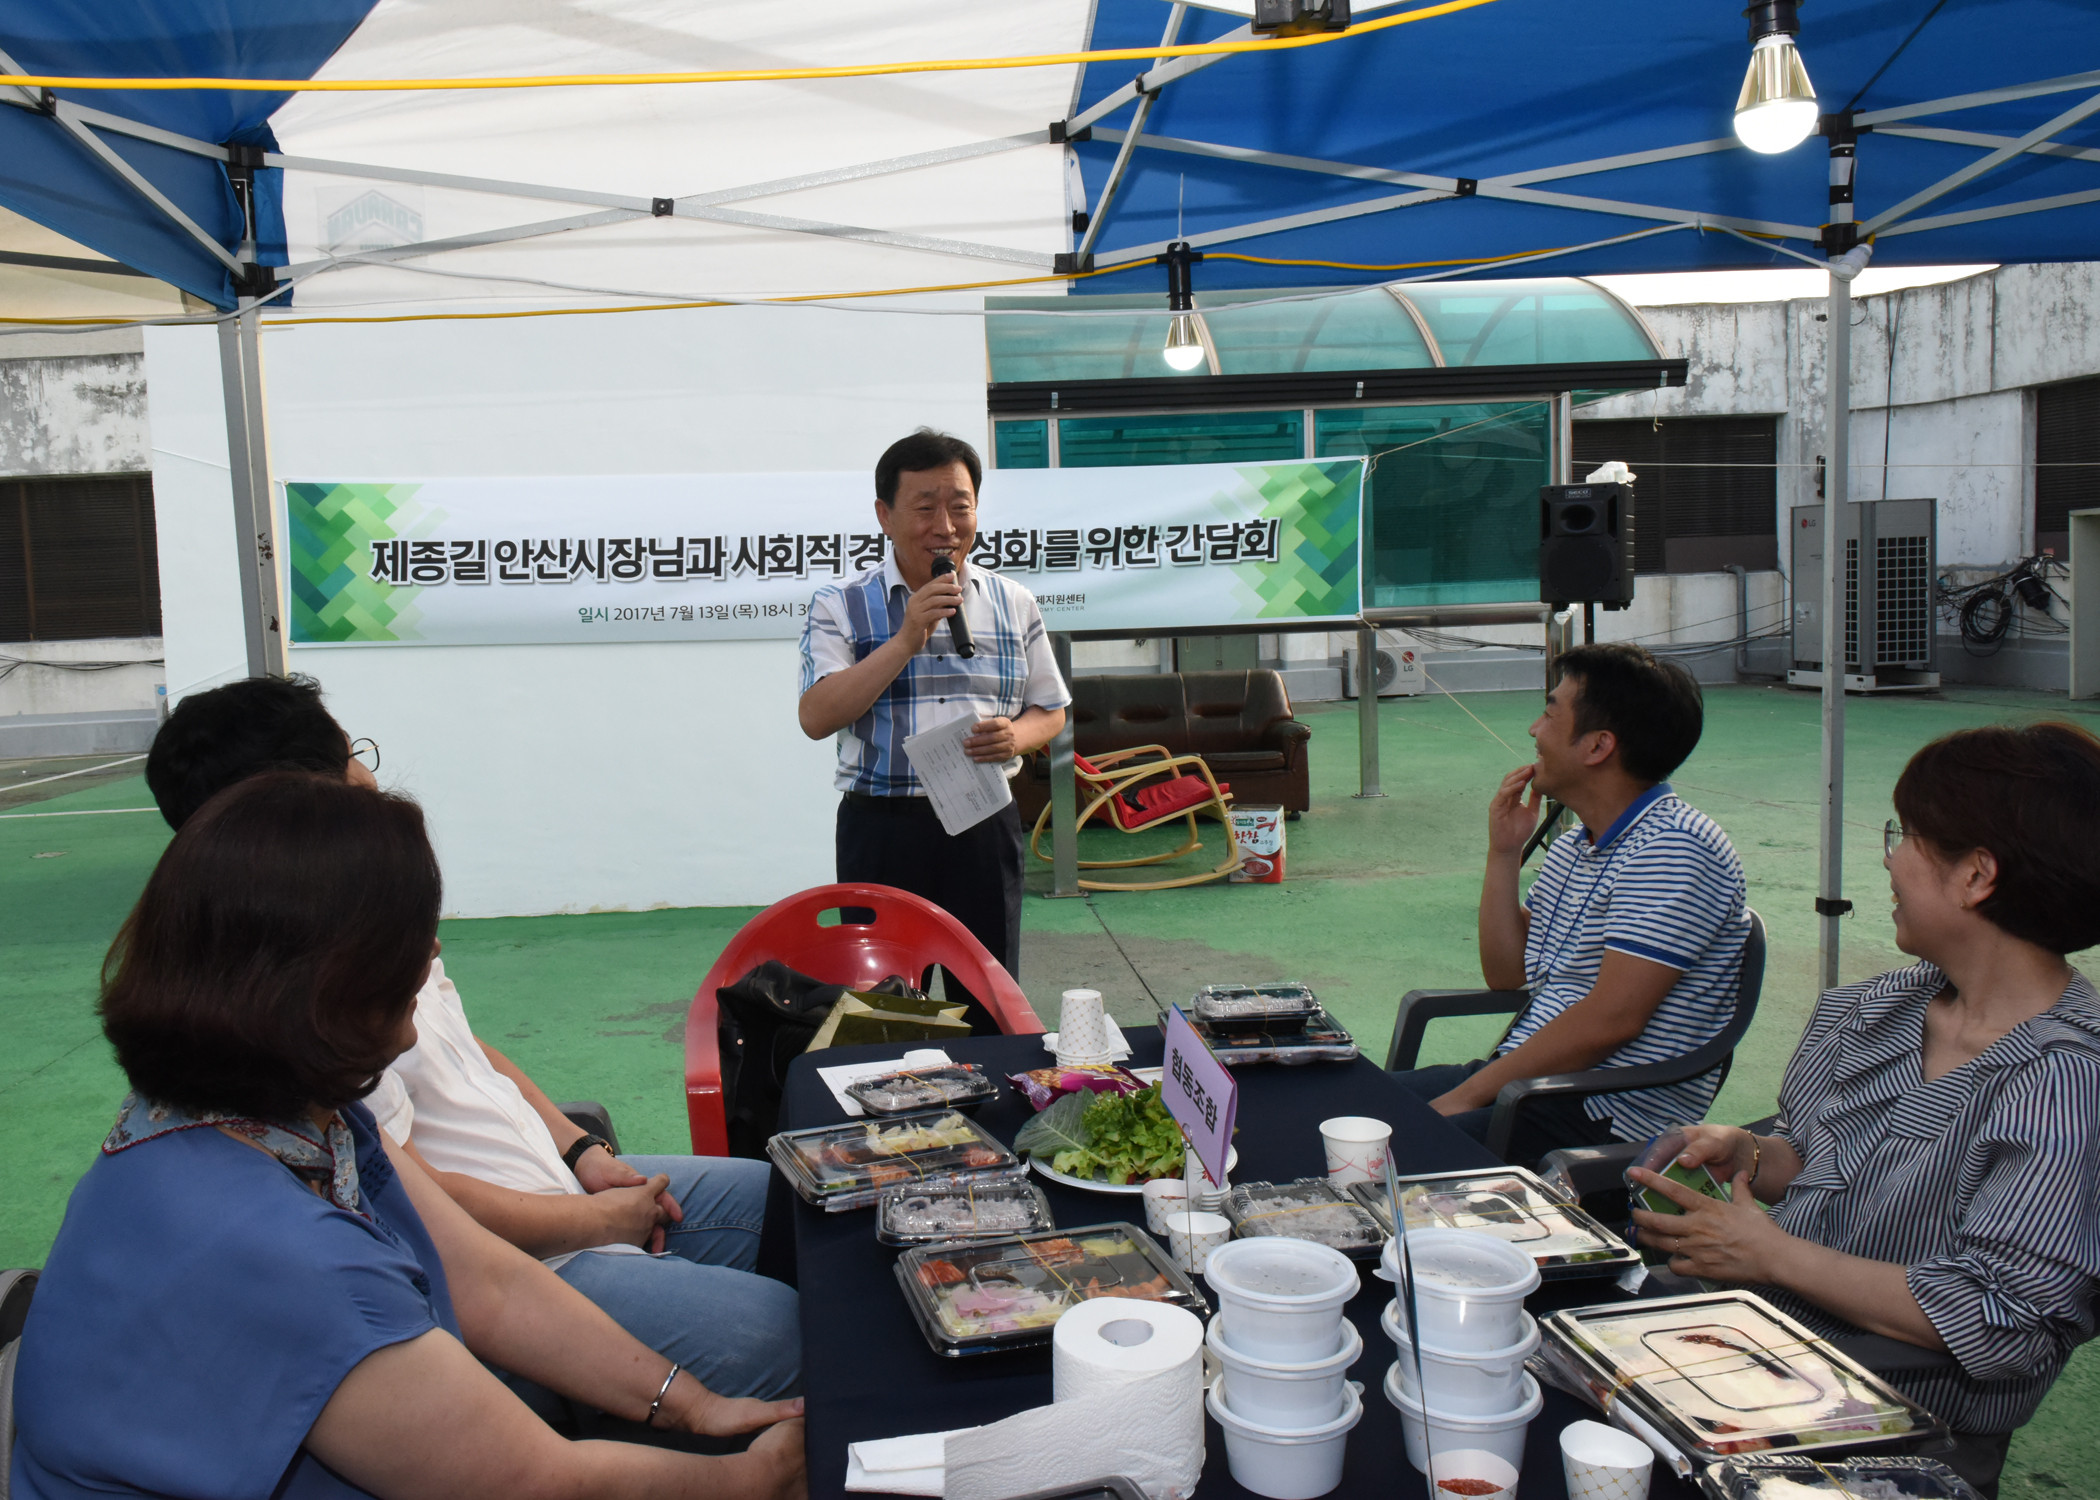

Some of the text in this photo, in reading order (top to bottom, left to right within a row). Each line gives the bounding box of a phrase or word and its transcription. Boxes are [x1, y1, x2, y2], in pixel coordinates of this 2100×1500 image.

[1808, 520, 1817, 528] LG
[371, 539, 487, 582] 제종길
[493, 536, 725, 581] 안산시장님과
[731, 534, 841, 577] 사회적
[849, 532, 894, 572] 경
[1085, 524, 1160, 567] 위한
[1165, 518, 1278, 563] 간담회
[578, 607, 609, 623] 일시
[614, 606, 665, 621] 2017년
[669, 606, 694, 621] 7월
[699, 604, 729, 620] 13일
[732, 603, 759, 620] (목)
[762, 602, 793, 618] 18시
[1403, 664, 1414, 672] LG
[1171, 1047, 1218, 1135] 협동조합
